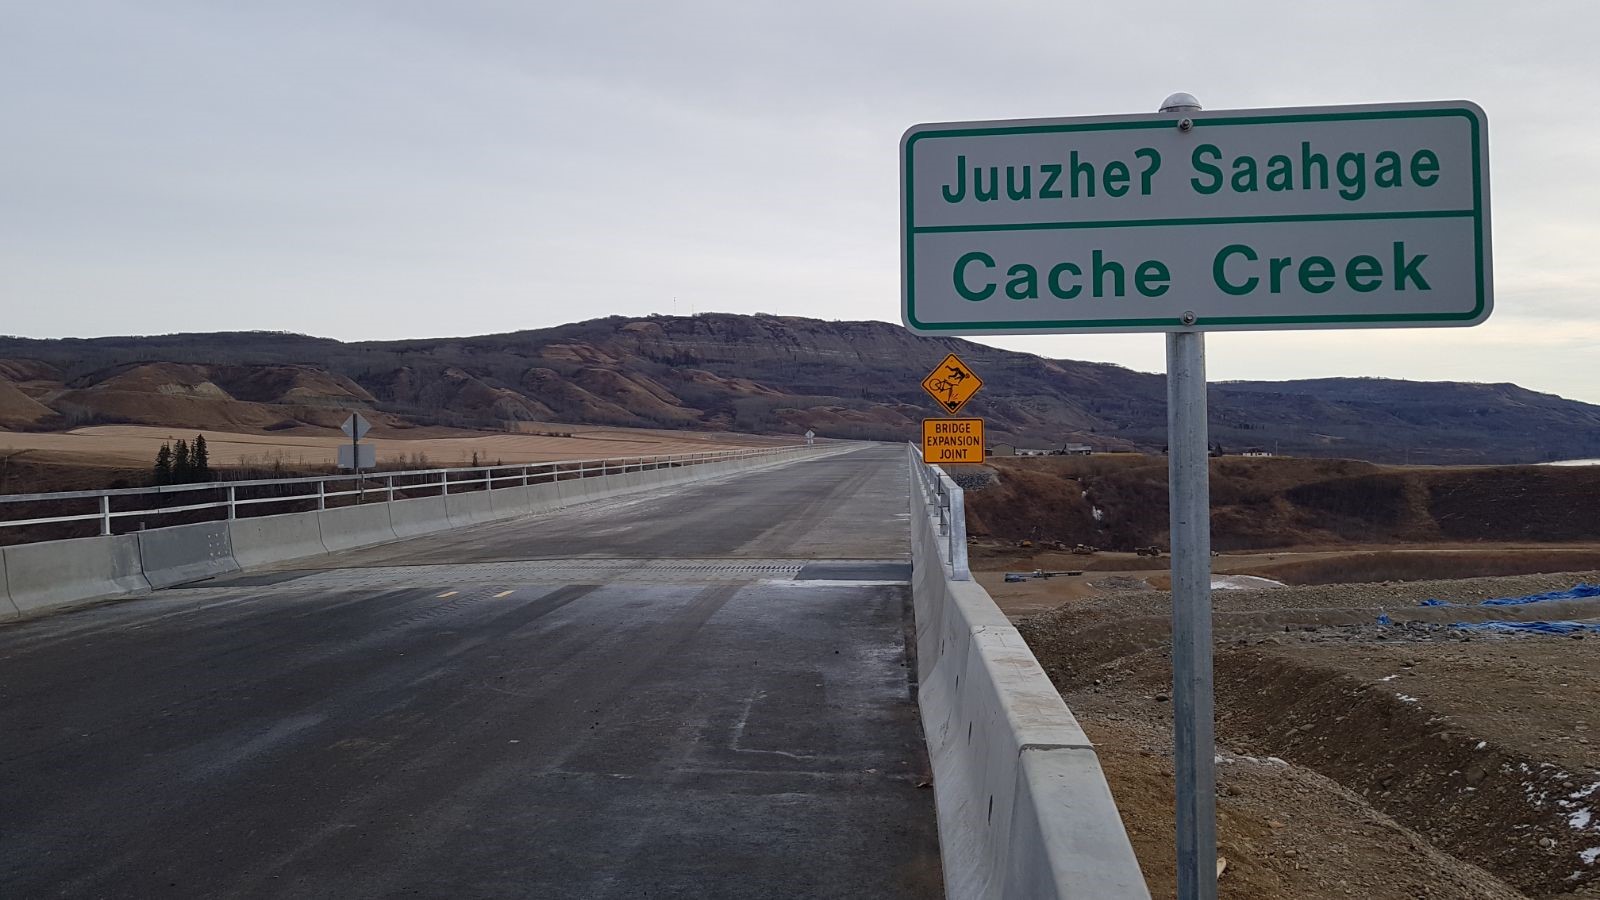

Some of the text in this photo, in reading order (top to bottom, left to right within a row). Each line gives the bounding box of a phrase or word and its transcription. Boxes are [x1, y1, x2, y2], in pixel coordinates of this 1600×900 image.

[1191, 141, 1440, 203] Saahgae
[953, 240, 1431, 302] Cache Creek
[936, 424, 970, 433] BRIDGE
[927, 436, 979, 446] EXPANSION
[940, 449, 967, 459] JOINT
